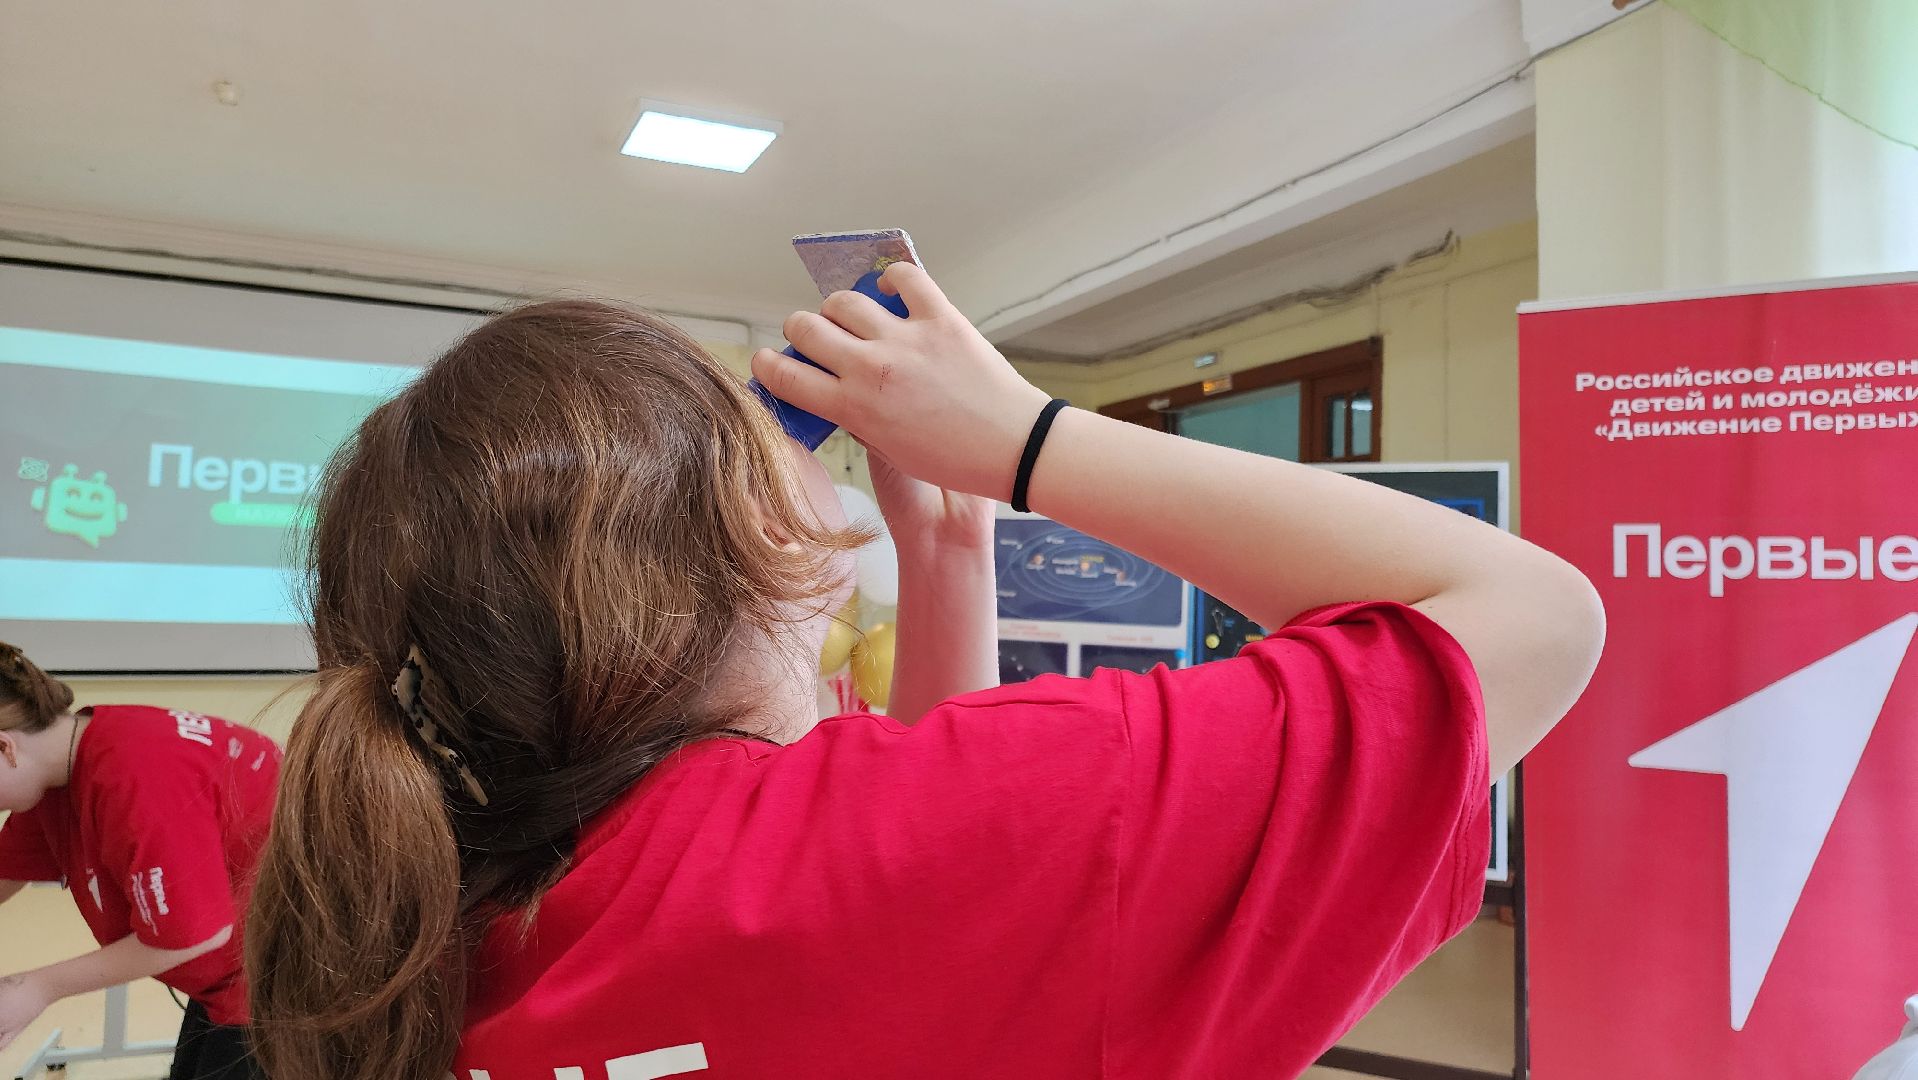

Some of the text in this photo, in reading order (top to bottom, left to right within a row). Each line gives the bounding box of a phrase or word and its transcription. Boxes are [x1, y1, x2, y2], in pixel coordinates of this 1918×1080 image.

[1575, 359, 1918, 392] Российское движен
[1609, 382, 1918, 418] детей и молодёжи
[1595, 417, 1783, 442] «Движение
[1612, 523, 1918, 598] Первые
